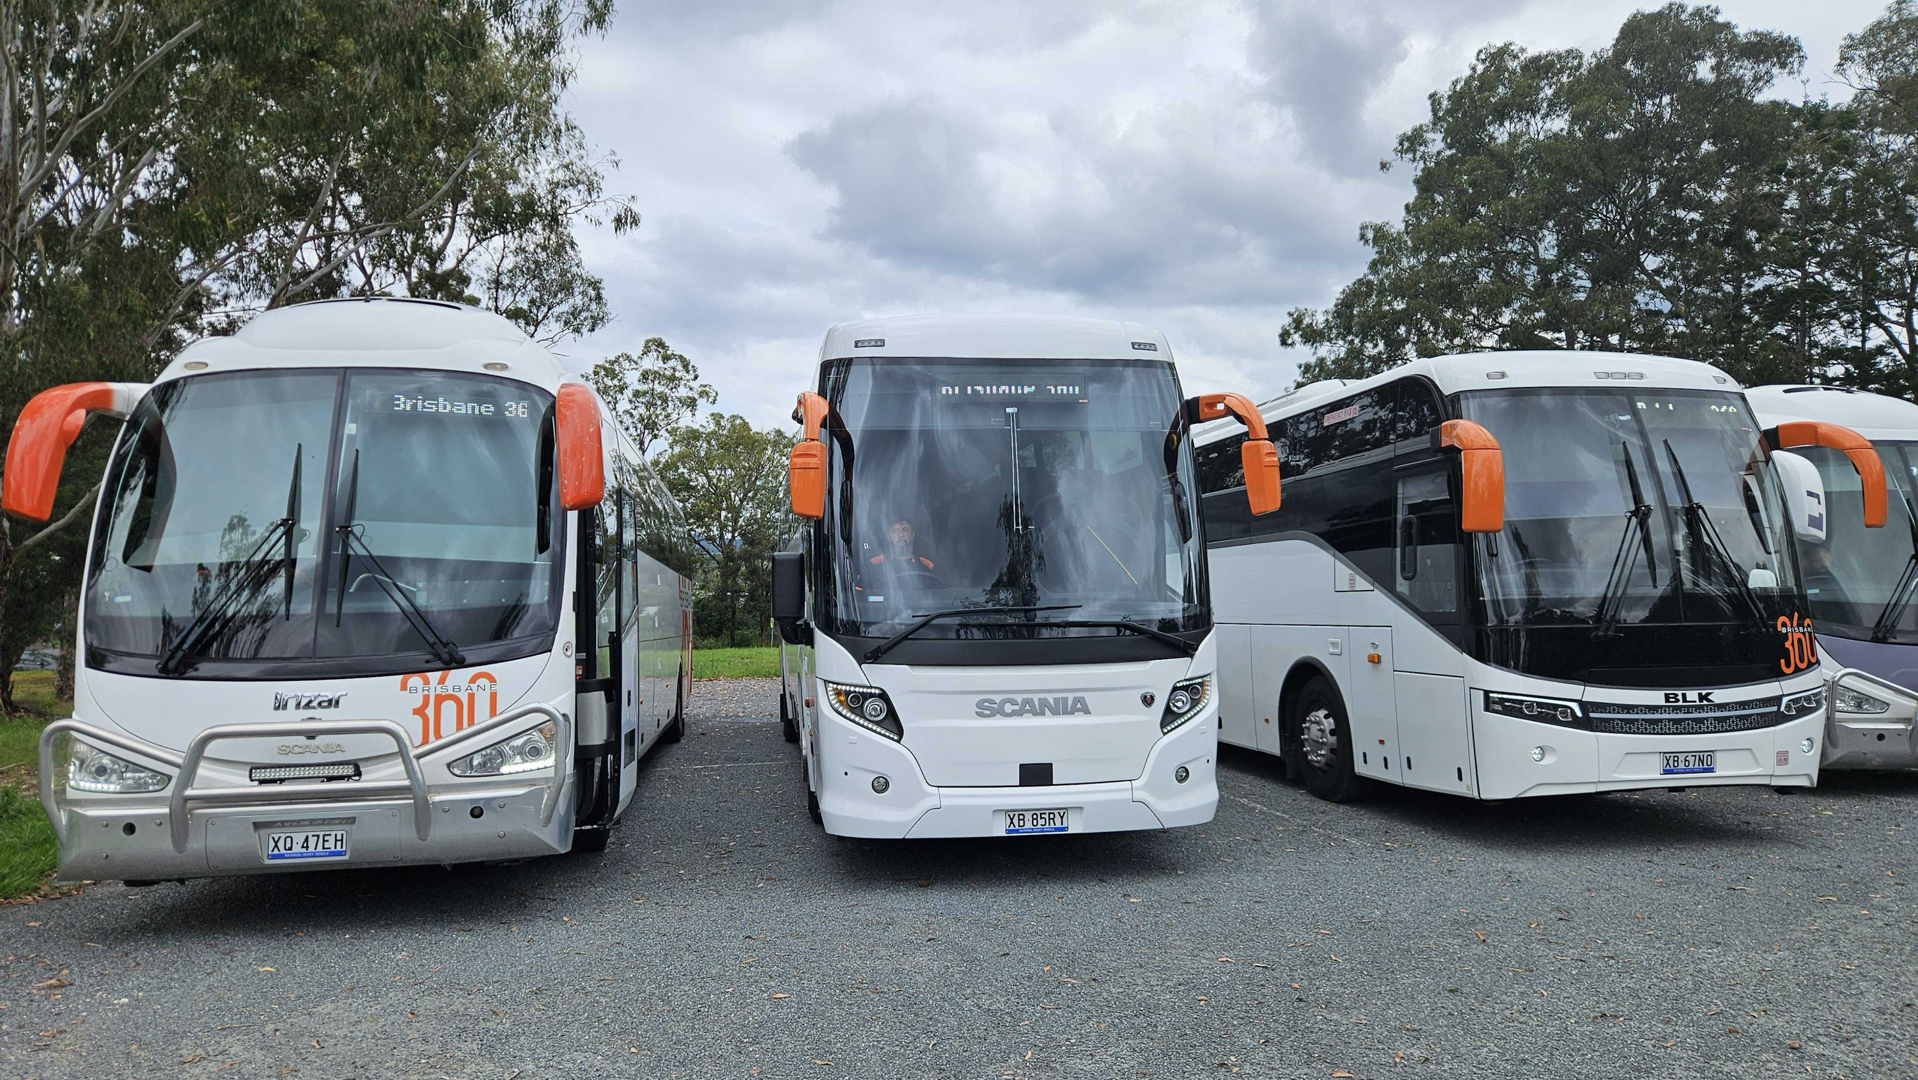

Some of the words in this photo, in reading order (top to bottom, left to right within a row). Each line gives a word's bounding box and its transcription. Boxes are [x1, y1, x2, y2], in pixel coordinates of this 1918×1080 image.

[1777, 611, 1817, 674] 360
[408, 684, 498, 694] BRISBANE
[1663, 691, 1715, 704] BLK
[400, 669, 498, 746] 360
[975, 696, 1092, 718] SCANIA
[277, 742, 346, 755] SCANIA
